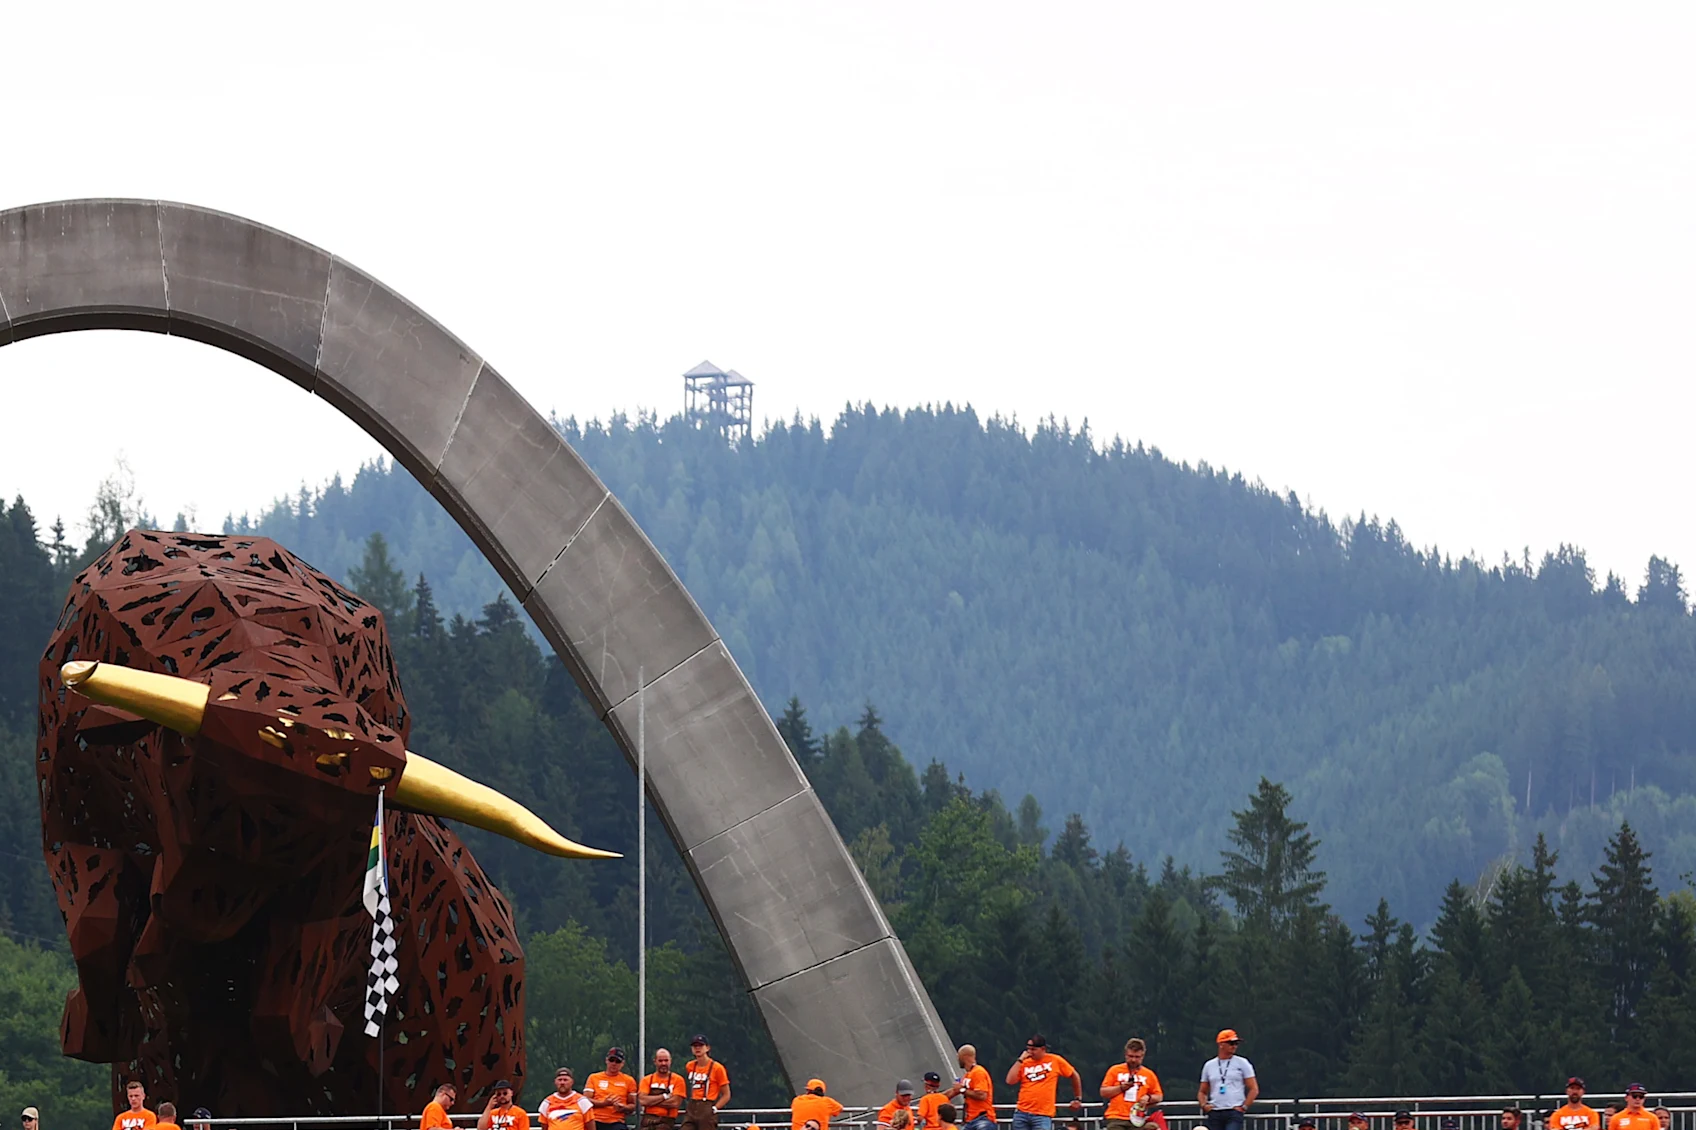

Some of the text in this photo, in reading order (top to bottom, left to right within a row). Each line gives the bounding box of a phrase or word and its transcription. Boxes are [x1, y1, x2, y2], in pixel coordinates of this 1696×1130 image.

[1025, 1063, 1052, 1074] MAX
[122, 1119, 144, 1127] MAX
[1561, 1116, 1588, 1126] MAX
